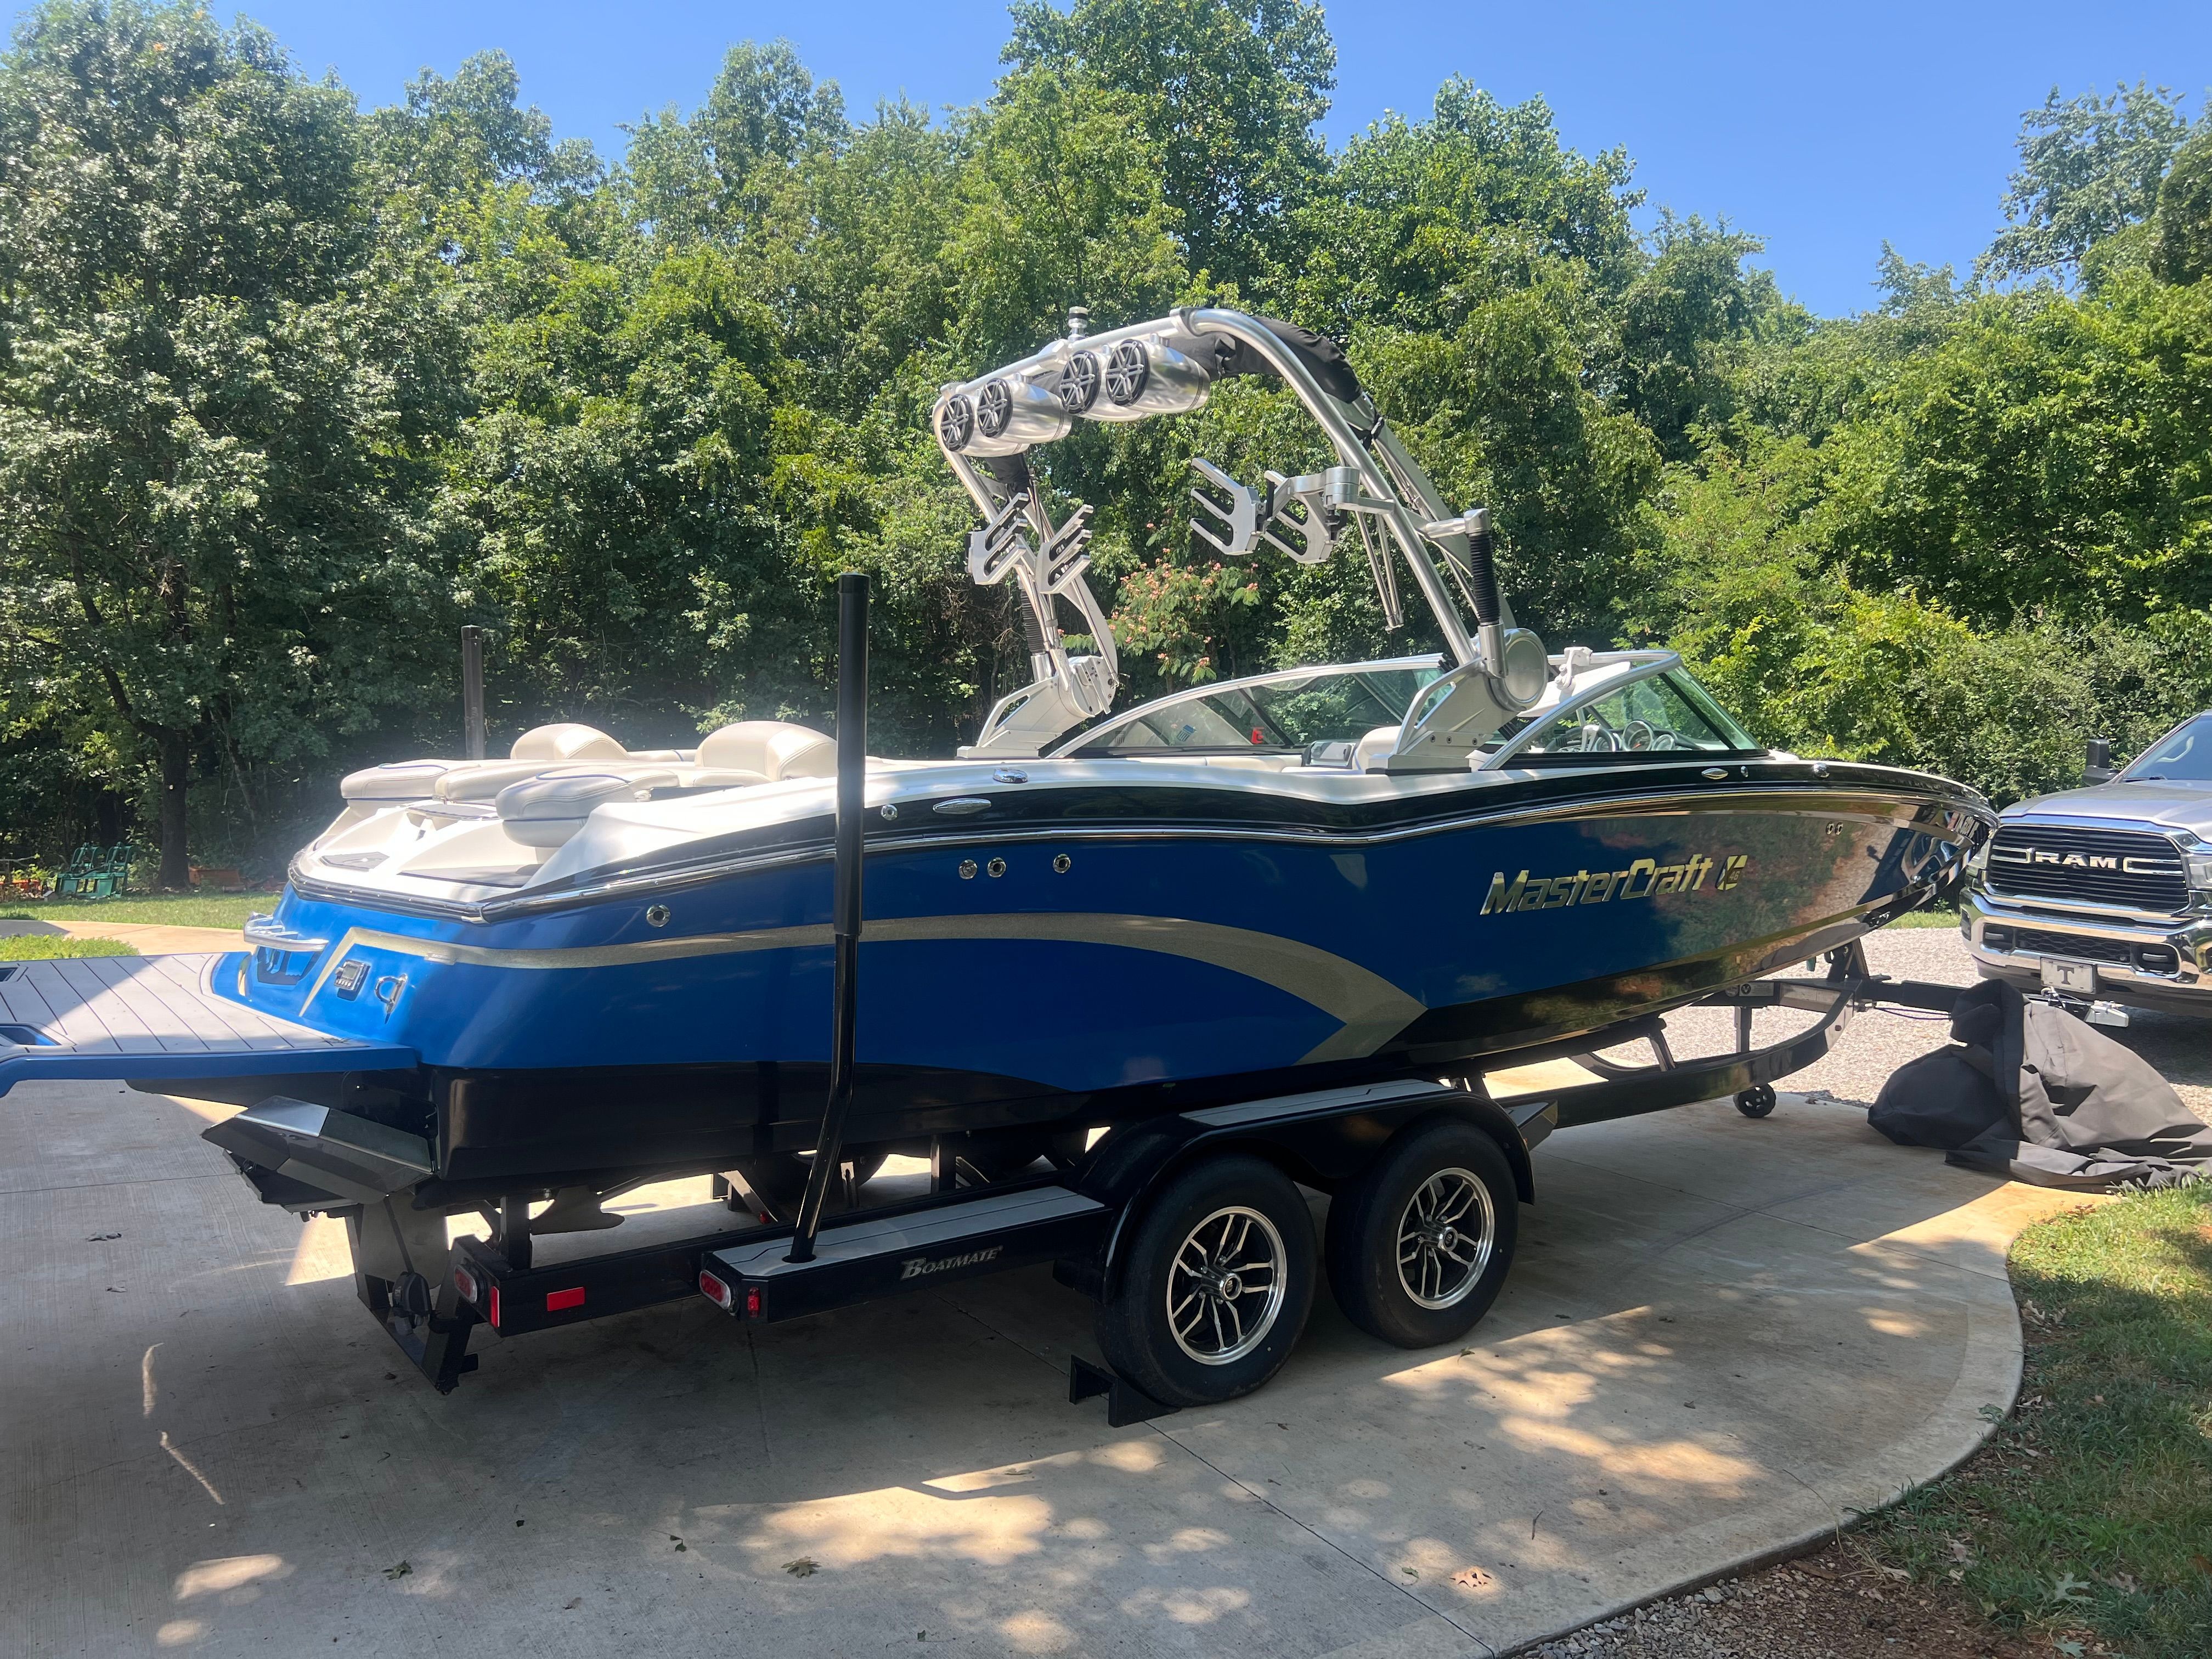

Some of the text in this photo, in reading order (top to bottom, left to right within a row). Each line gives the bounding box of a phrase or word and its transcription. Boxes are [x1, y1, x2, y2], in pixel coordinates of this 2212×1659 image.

[2035, 851, 2118, 870] RAM
[1480, 854, 1713, 915] MasterCraft
[2057, 965, 2075, 985] T
